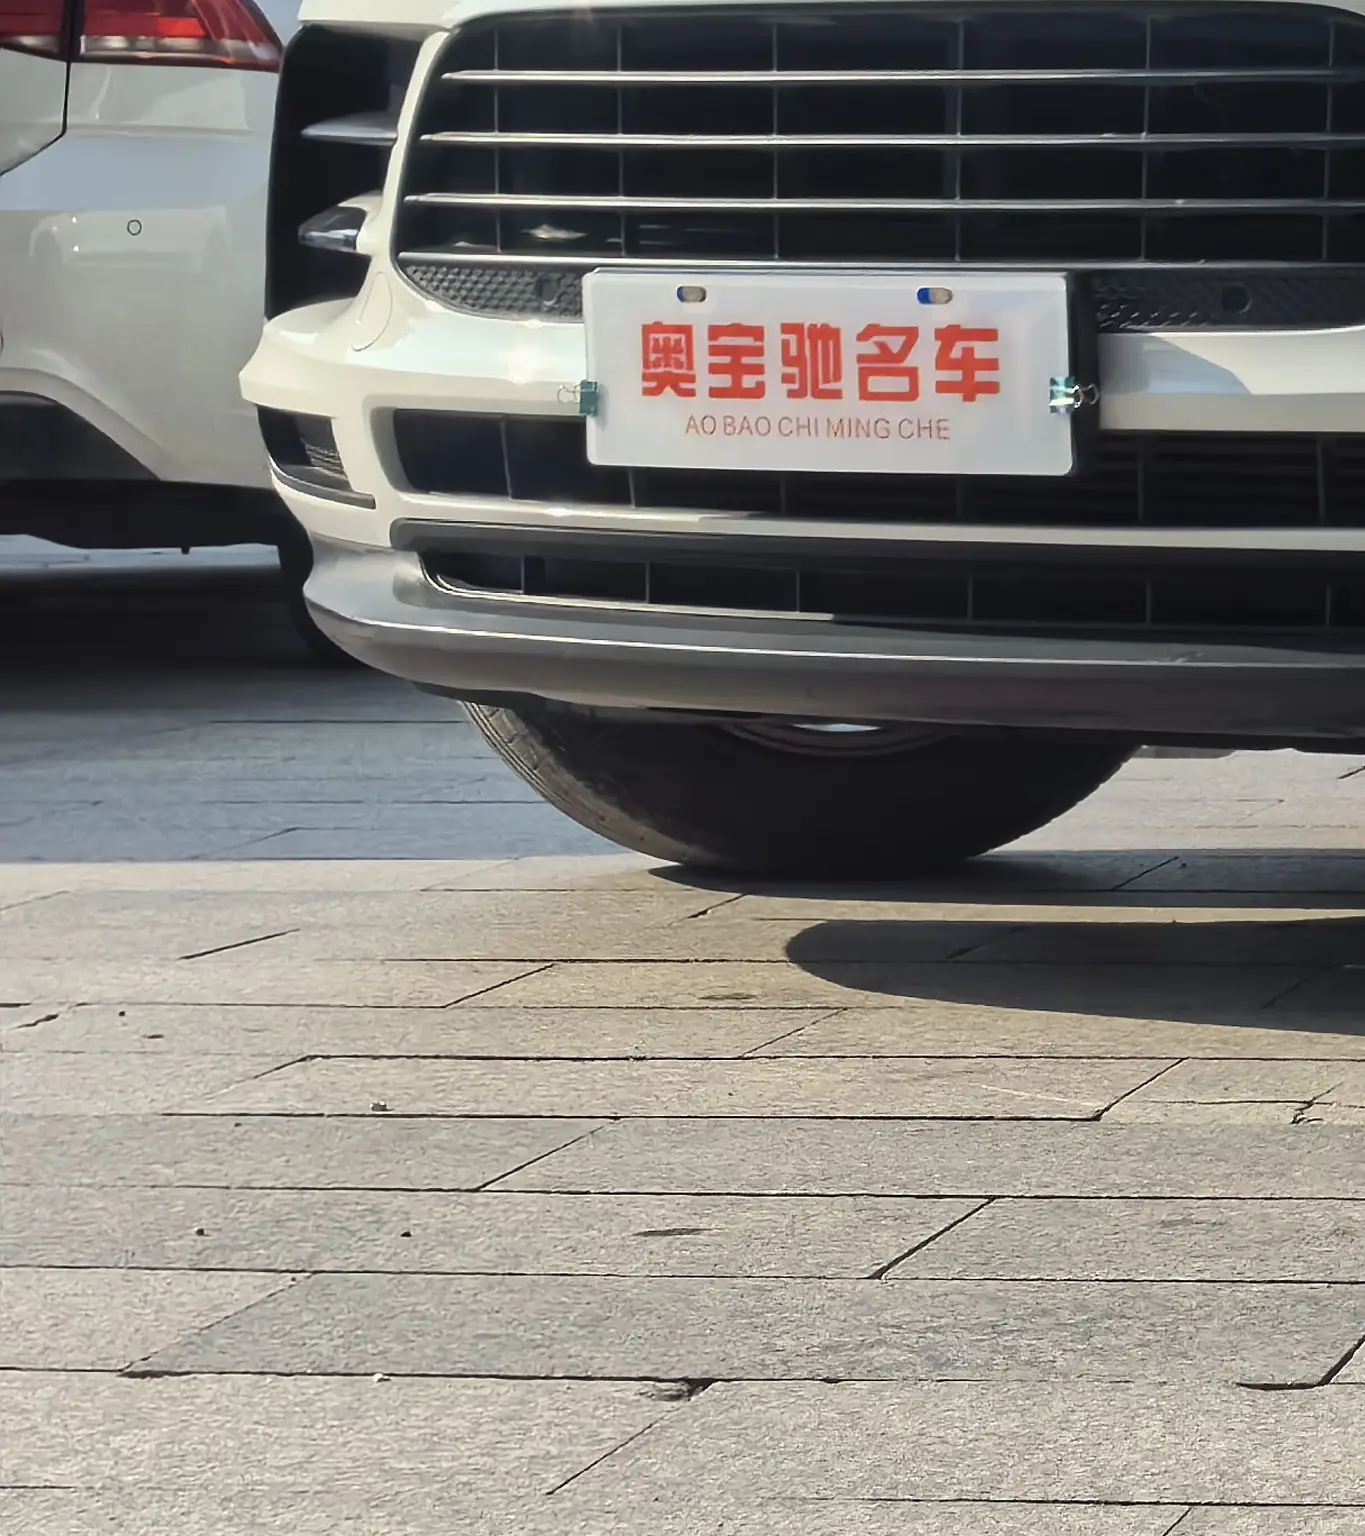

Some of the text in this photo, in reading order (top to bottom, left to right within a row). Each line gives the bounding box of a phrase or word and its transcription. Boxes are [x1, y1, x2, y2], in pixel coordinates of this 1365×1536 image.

[641, 321, 1000, 403] 奥宝驰名车
[685, 414, 951, 441] AO BAO CHI MING CHE
